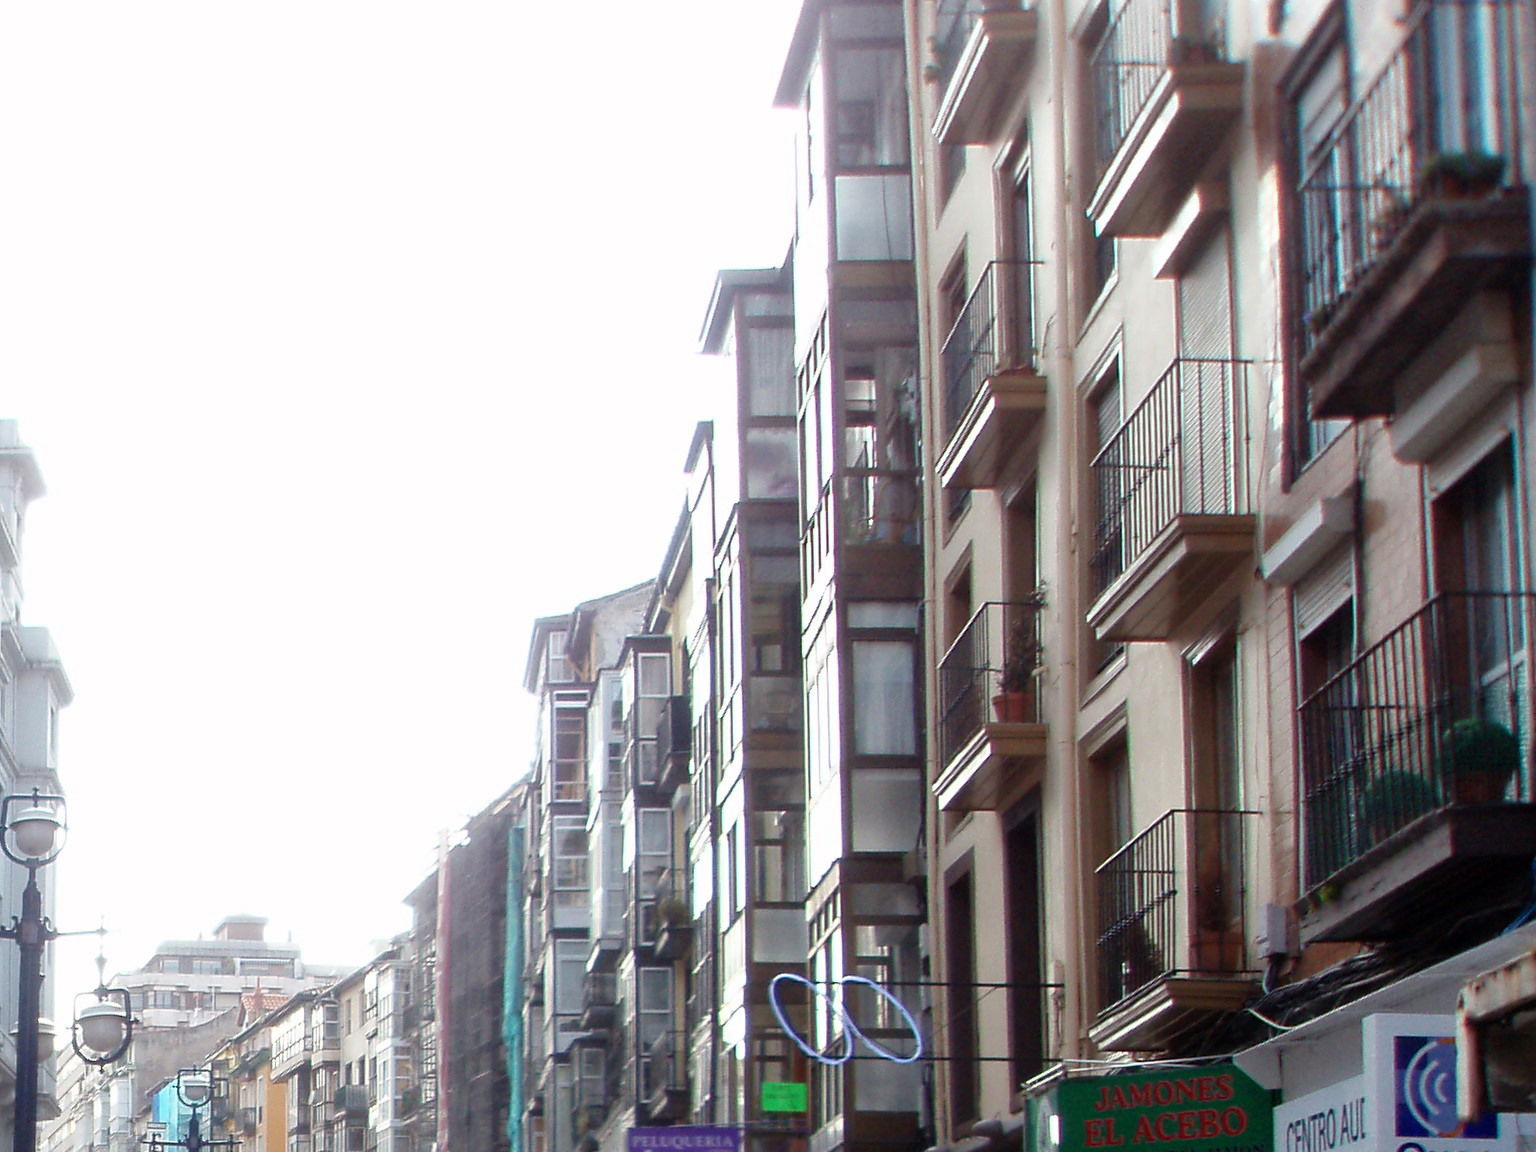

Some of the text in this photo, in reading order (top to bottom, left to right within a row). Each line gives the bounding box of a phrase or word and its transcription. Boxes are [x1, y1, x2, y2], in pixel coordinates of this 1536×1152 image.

[1093, 1074, 1235, 1112] JAMONES
[1083, 1106, 1248, 1148] EL ACEBO
